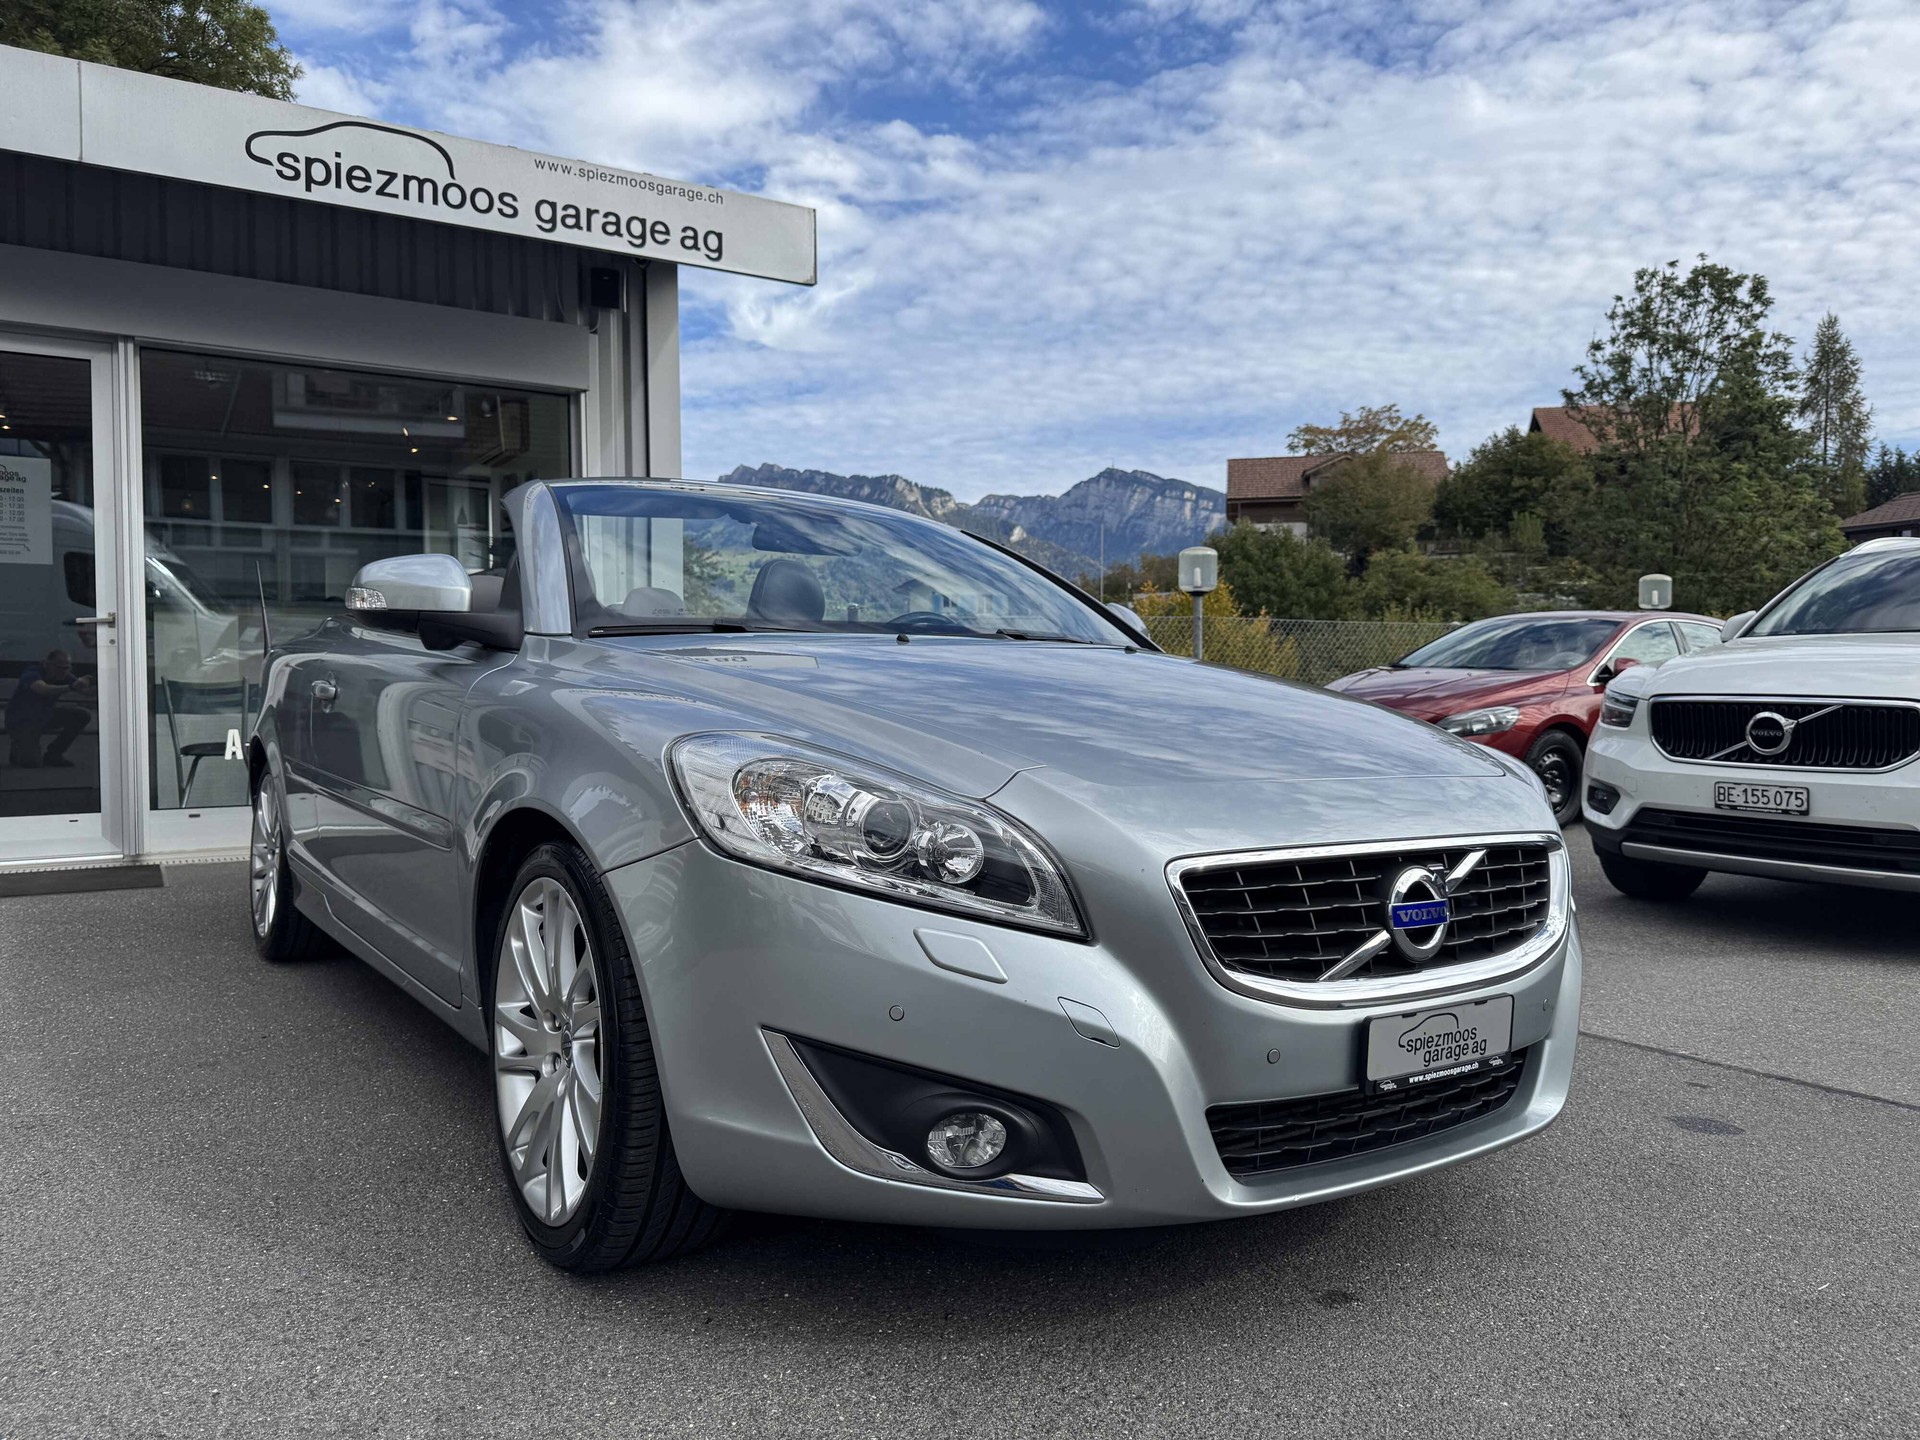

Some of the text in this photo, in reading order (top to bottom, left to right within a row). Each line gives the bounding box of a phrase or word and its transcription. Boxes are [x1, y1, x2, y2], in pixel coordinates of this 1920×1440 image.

[534, 158, 724, 205] www.spiezmoosgarage.ch
[275, 151, 724, 262] spiezmoos garage ag
[1750, 729, 1783, 737] VOLVO
[1397, 906, 1447, 922] VOLVO
[1406, 1027, 1477, 1056] spiezmoos
[1423, 1044, 1468, 1068] garage
[1472, 1038, 1487, 1056] ag
[1409, 1062, 1479, 1083] www.spiezmoosgarage.ch
